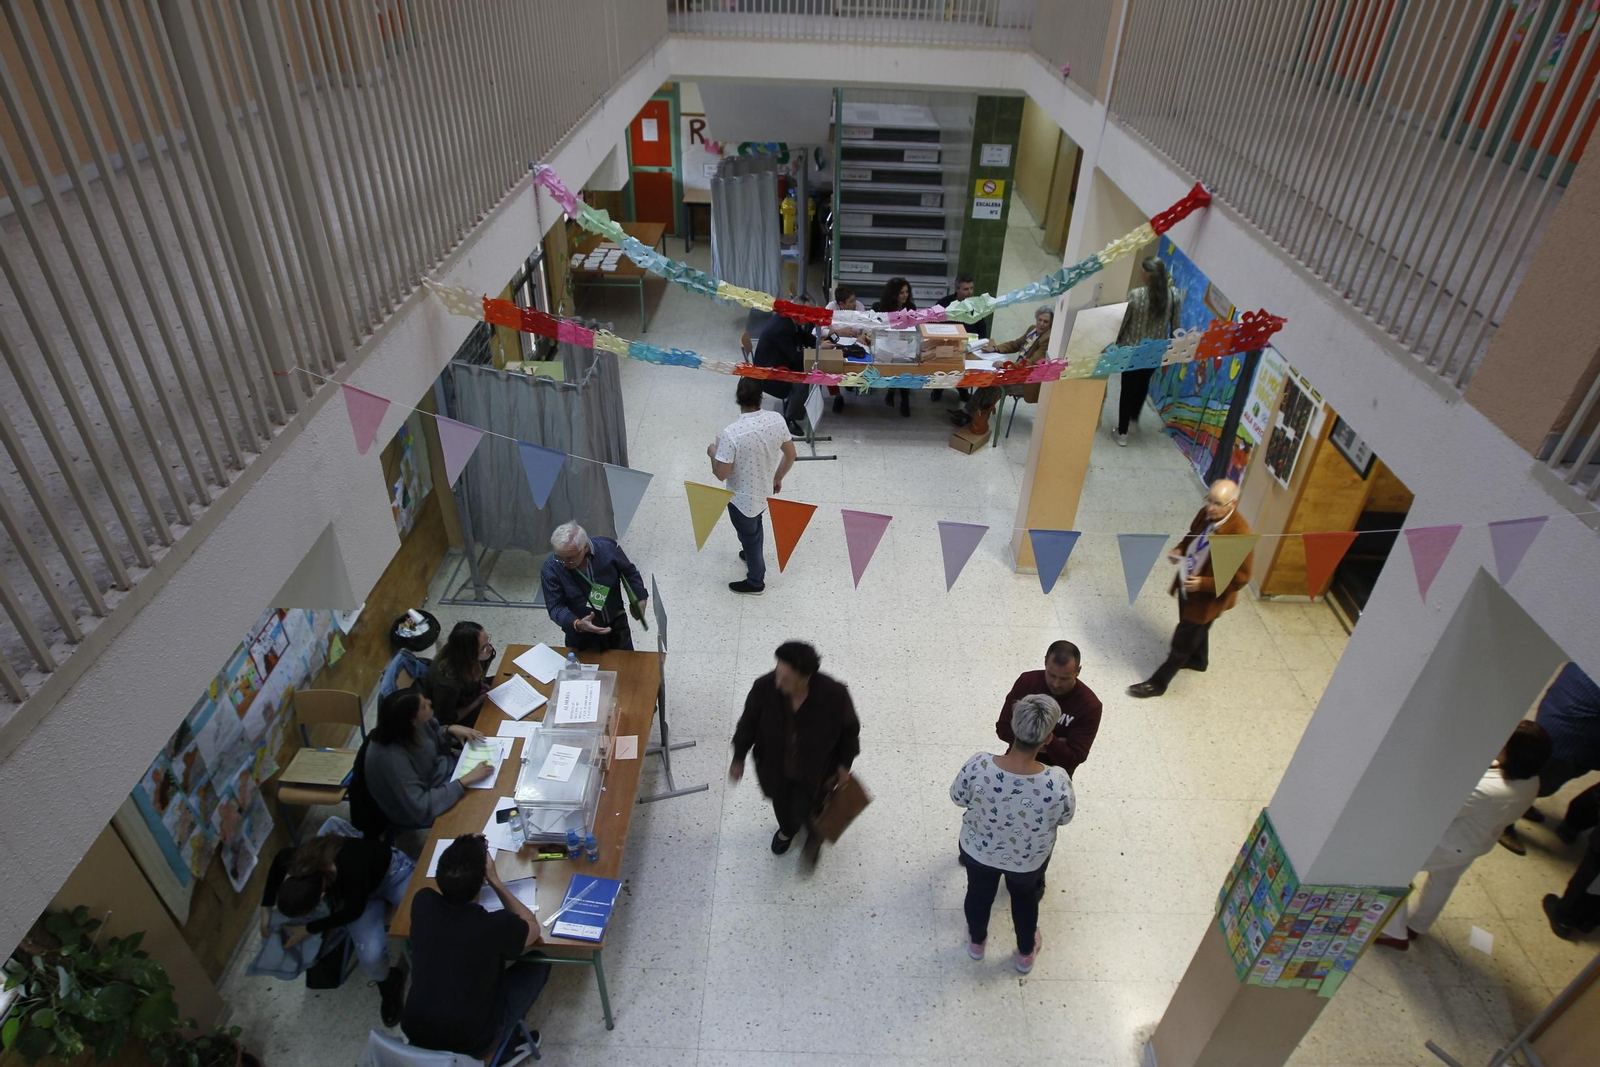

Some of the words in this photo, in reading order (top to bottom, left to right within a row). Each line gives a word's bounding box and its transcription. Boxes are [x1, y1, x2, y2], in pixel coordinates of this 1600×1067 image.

[1244, 411, 1254, 424] AULA
[590, 590, 607, 602] VOX
[1057, 713, 1075, 727] MY
